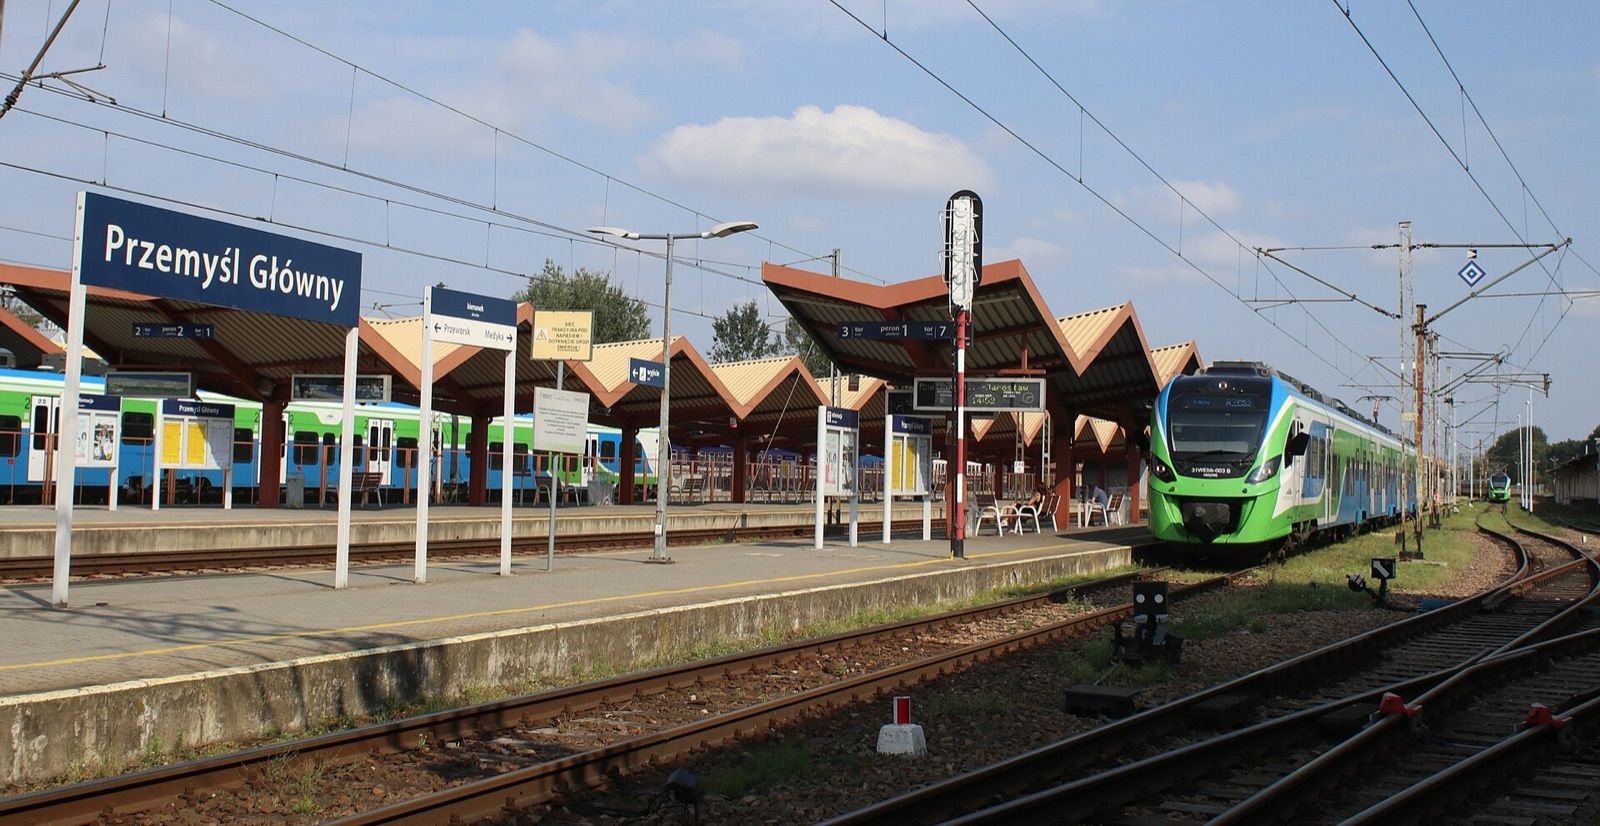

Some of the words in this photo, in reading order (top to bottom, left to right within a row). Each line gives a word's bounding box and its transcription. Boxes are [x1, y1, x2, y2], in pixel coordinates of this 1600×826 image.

[104, 223, 240, 290] Przemyśl
[249, 251, 345, 312] Główny
[135, 326, 141, 336] 2
[177, 325, 184, 337] 2
[206, 327, 211, 337] 1
[444, 323, 471, 336] Przeworsk
[484, 329, 505, 341] Medyka
[841, 326, 849, 337] 3
[880, 325, 900, 333] peron
[901, 324, 909, 337] 1
[939, 325, 947, 337] 7
[24, 397, 31, 410] 2
[178, 404, 201, 414] Przemyśl
[201, 406, 220, 415] Główny
[254, 412, 259, 423] 2
[289, 414, 294, 425] 2
[364, 420, 369, 430] 2
[392, 422, 398, 432] 2
